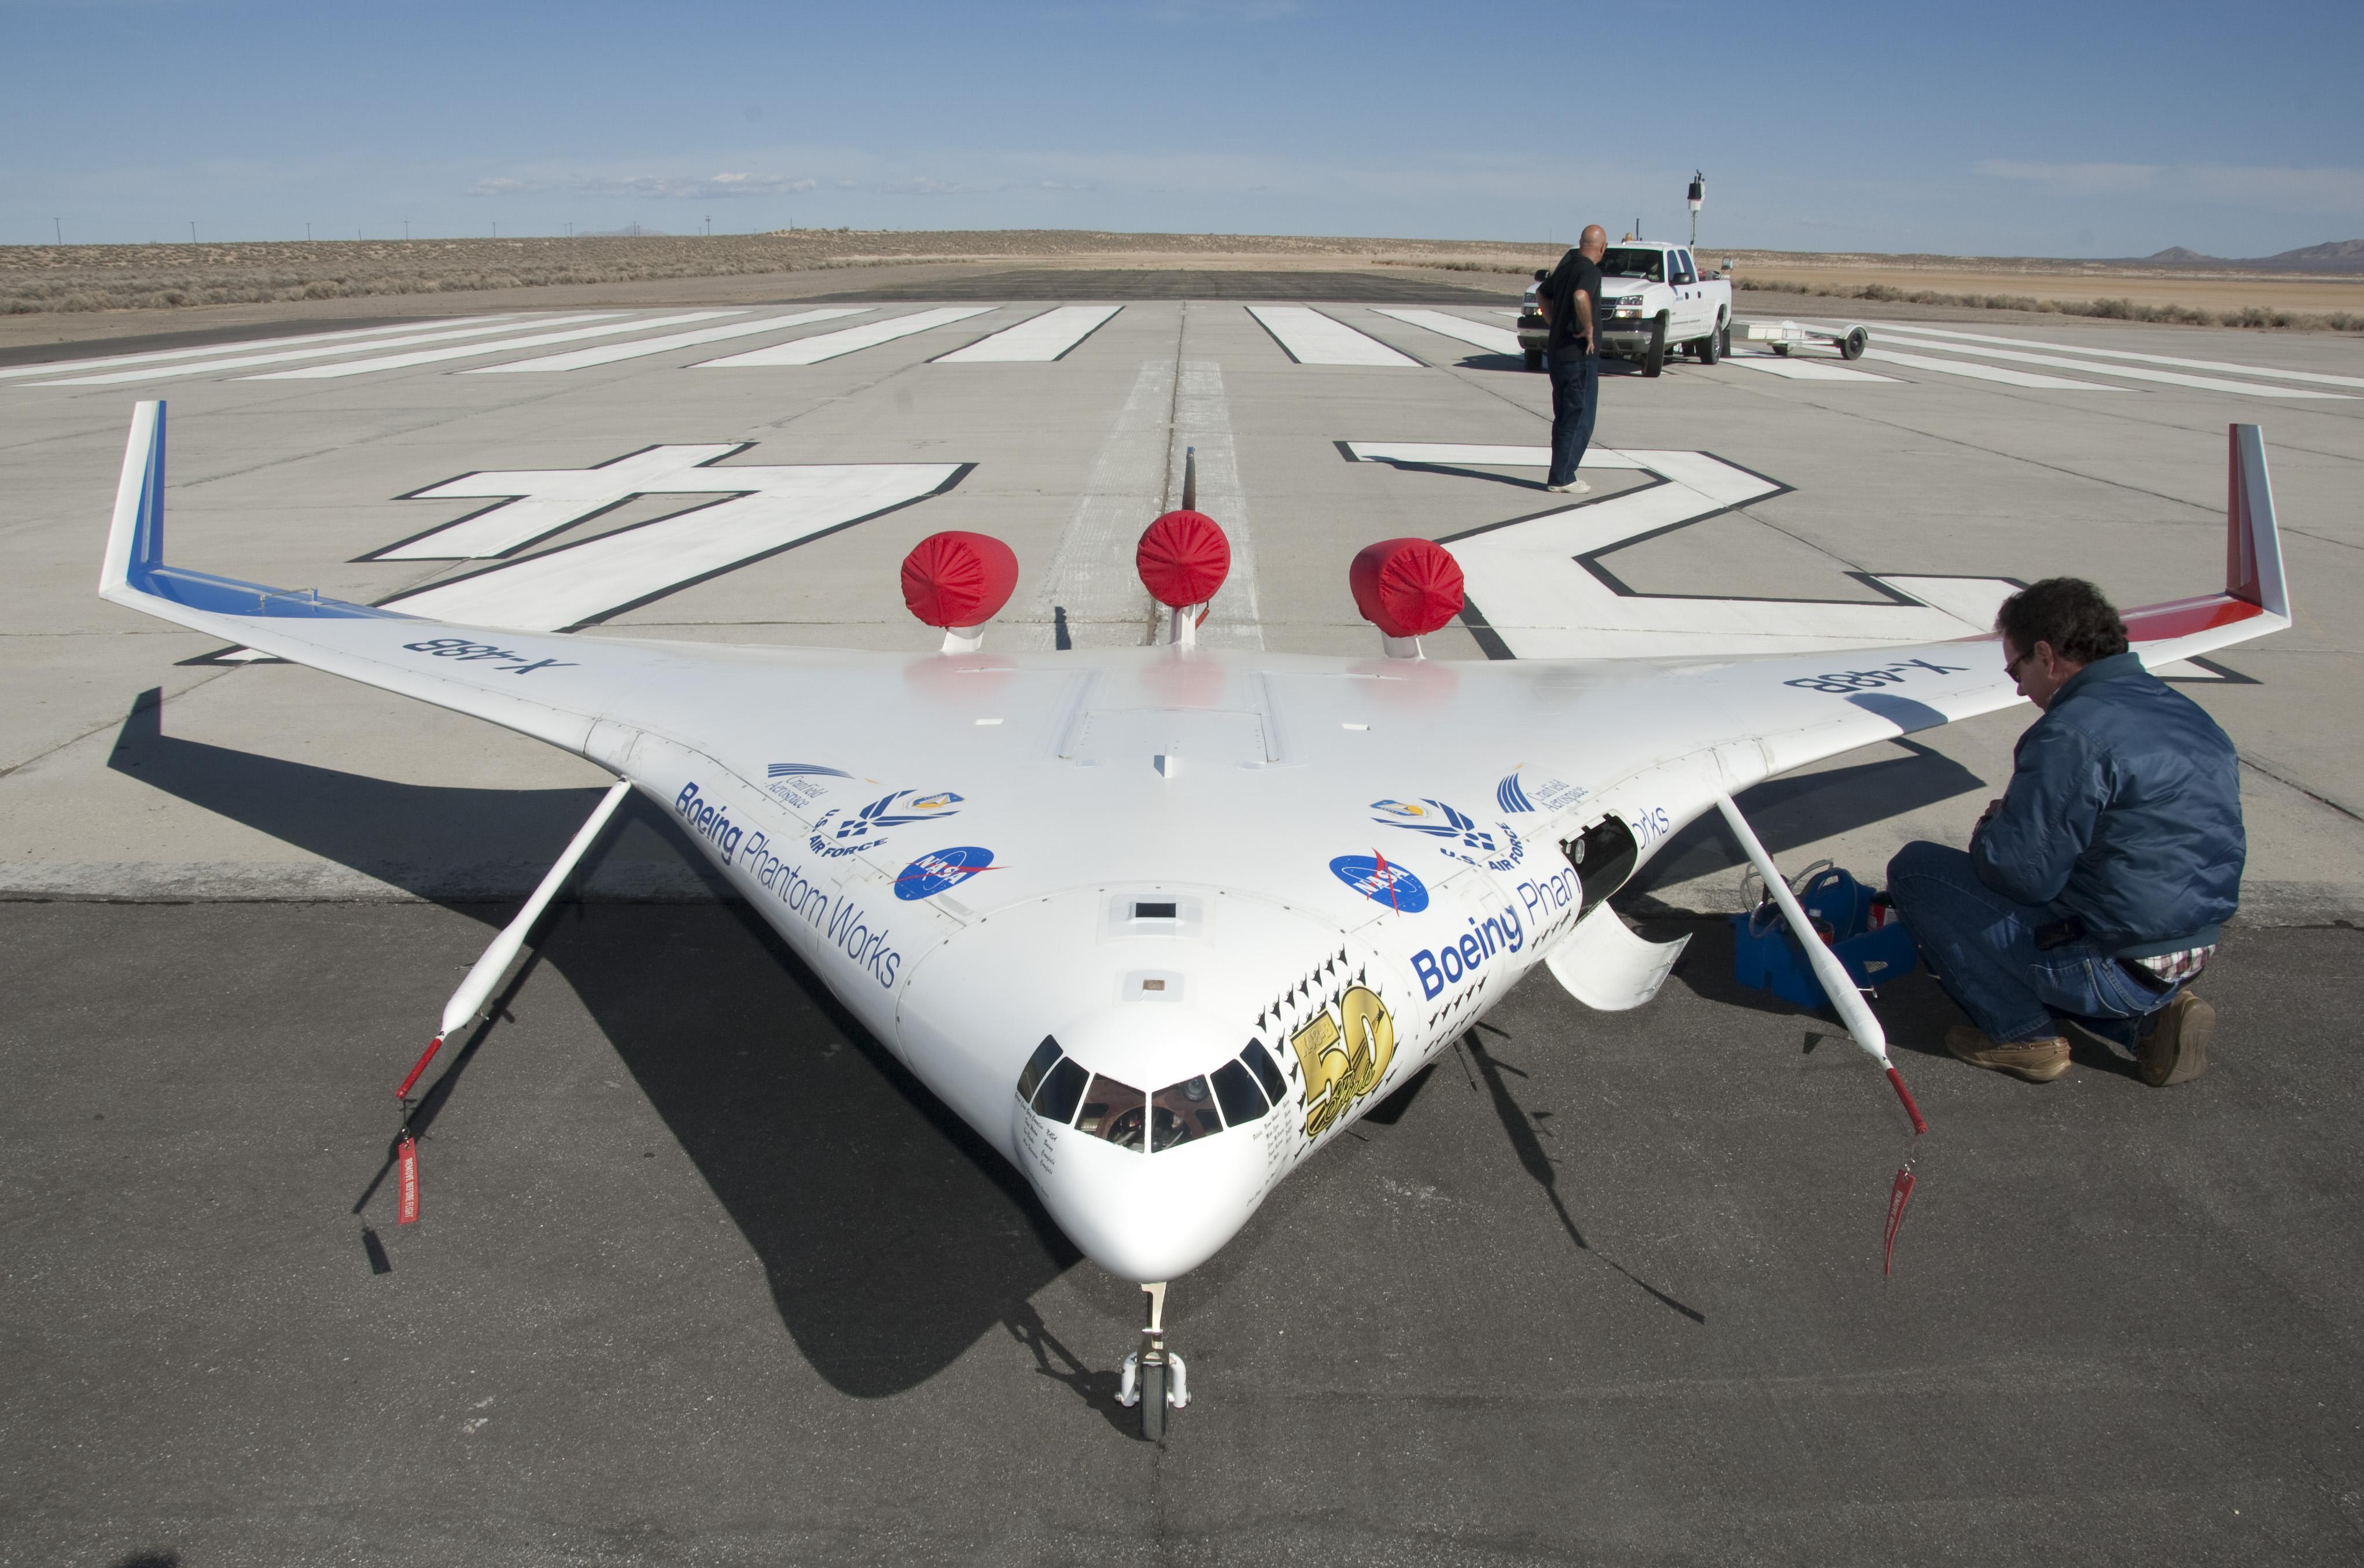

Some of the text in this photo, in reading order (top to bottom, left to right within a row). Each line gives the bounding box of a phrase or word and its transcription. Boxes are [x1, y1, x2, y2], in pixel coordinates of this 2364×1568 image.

[403, 639, 581, 675] X-48B
[1783, 659, 1971, 693] X-48B
[765, 780, 809, 809] Aerospace
[786, 776, 828, 798] Cranfield
[1526, 779, 1570, 801] Cranfield
[1541, 786, 1589, 813] Aerospace
[810, 835, 826, 854] AIR
[821, 838, 888, 858] FORCE
[1495, 822, 1523, 865] FORCE
[915, 855, 968, 885] NASA
[1488, 859, 1515, 870] AIR
[675, 781, 900, 988] Boeing Phantom Works
[1352, 866, 1411, 895] NASA
[1409, 904, 1523, 1001] Boeing
[1516, 867, 1581, 925] Phan
[1290, 986, 1394, 1137] 50
[405, 1157, 414, 1217] REMOVE BEFORE FLIGHT
[1891, 1190, 1903, 1217] REMOVE
